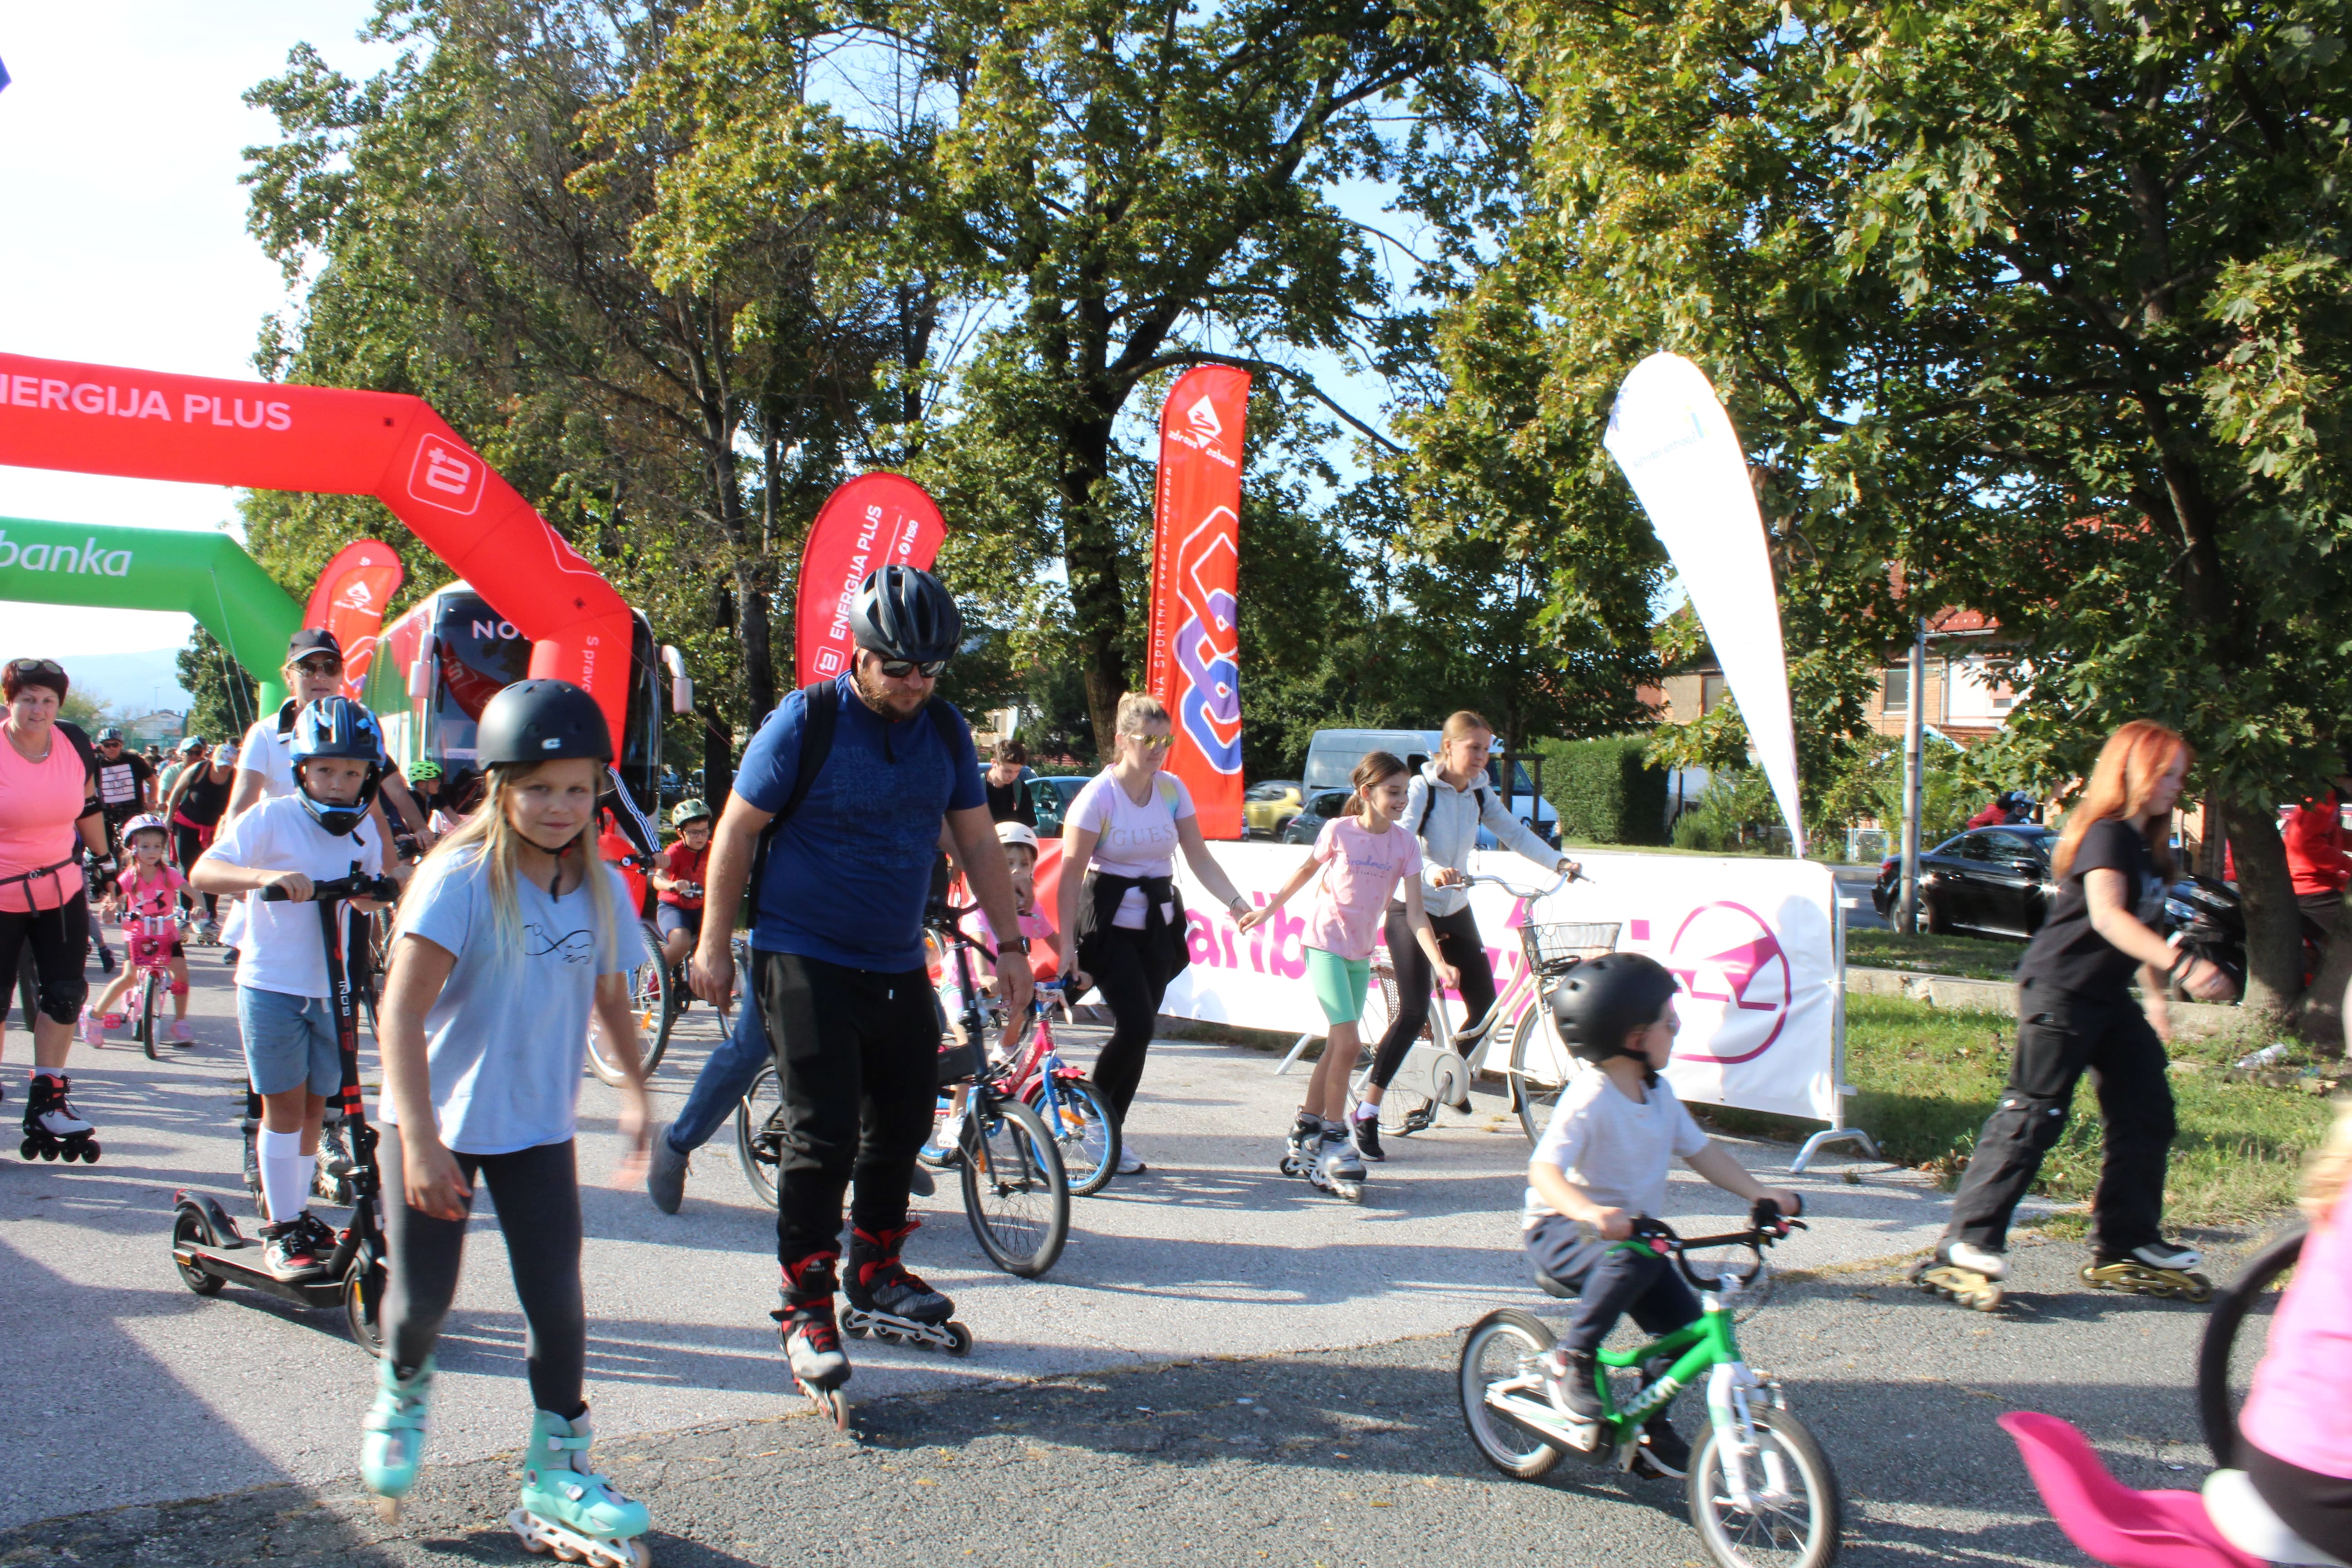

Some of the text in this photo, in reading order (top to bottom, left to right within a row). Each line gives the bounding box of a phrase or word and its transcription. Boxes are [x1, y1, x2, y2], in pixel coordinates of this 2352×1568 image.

[0, 373, 292, 431] ERGIJA PLUS
[1162, 467, 1172, 535] MARIBOR
[0, 530, 133, 577] banka
[901, 519, 919, 543] hse
[829, 504, 883, 641] ENERGIJA PLUS
[1159, 544, 1167, 589] ZVEZA
[472, 619, 529, 640] NO
[587, 636, 599, 646] S
[1112, 823, 1175, 846] GUES
[1185, 891, 1307, 980] arib
